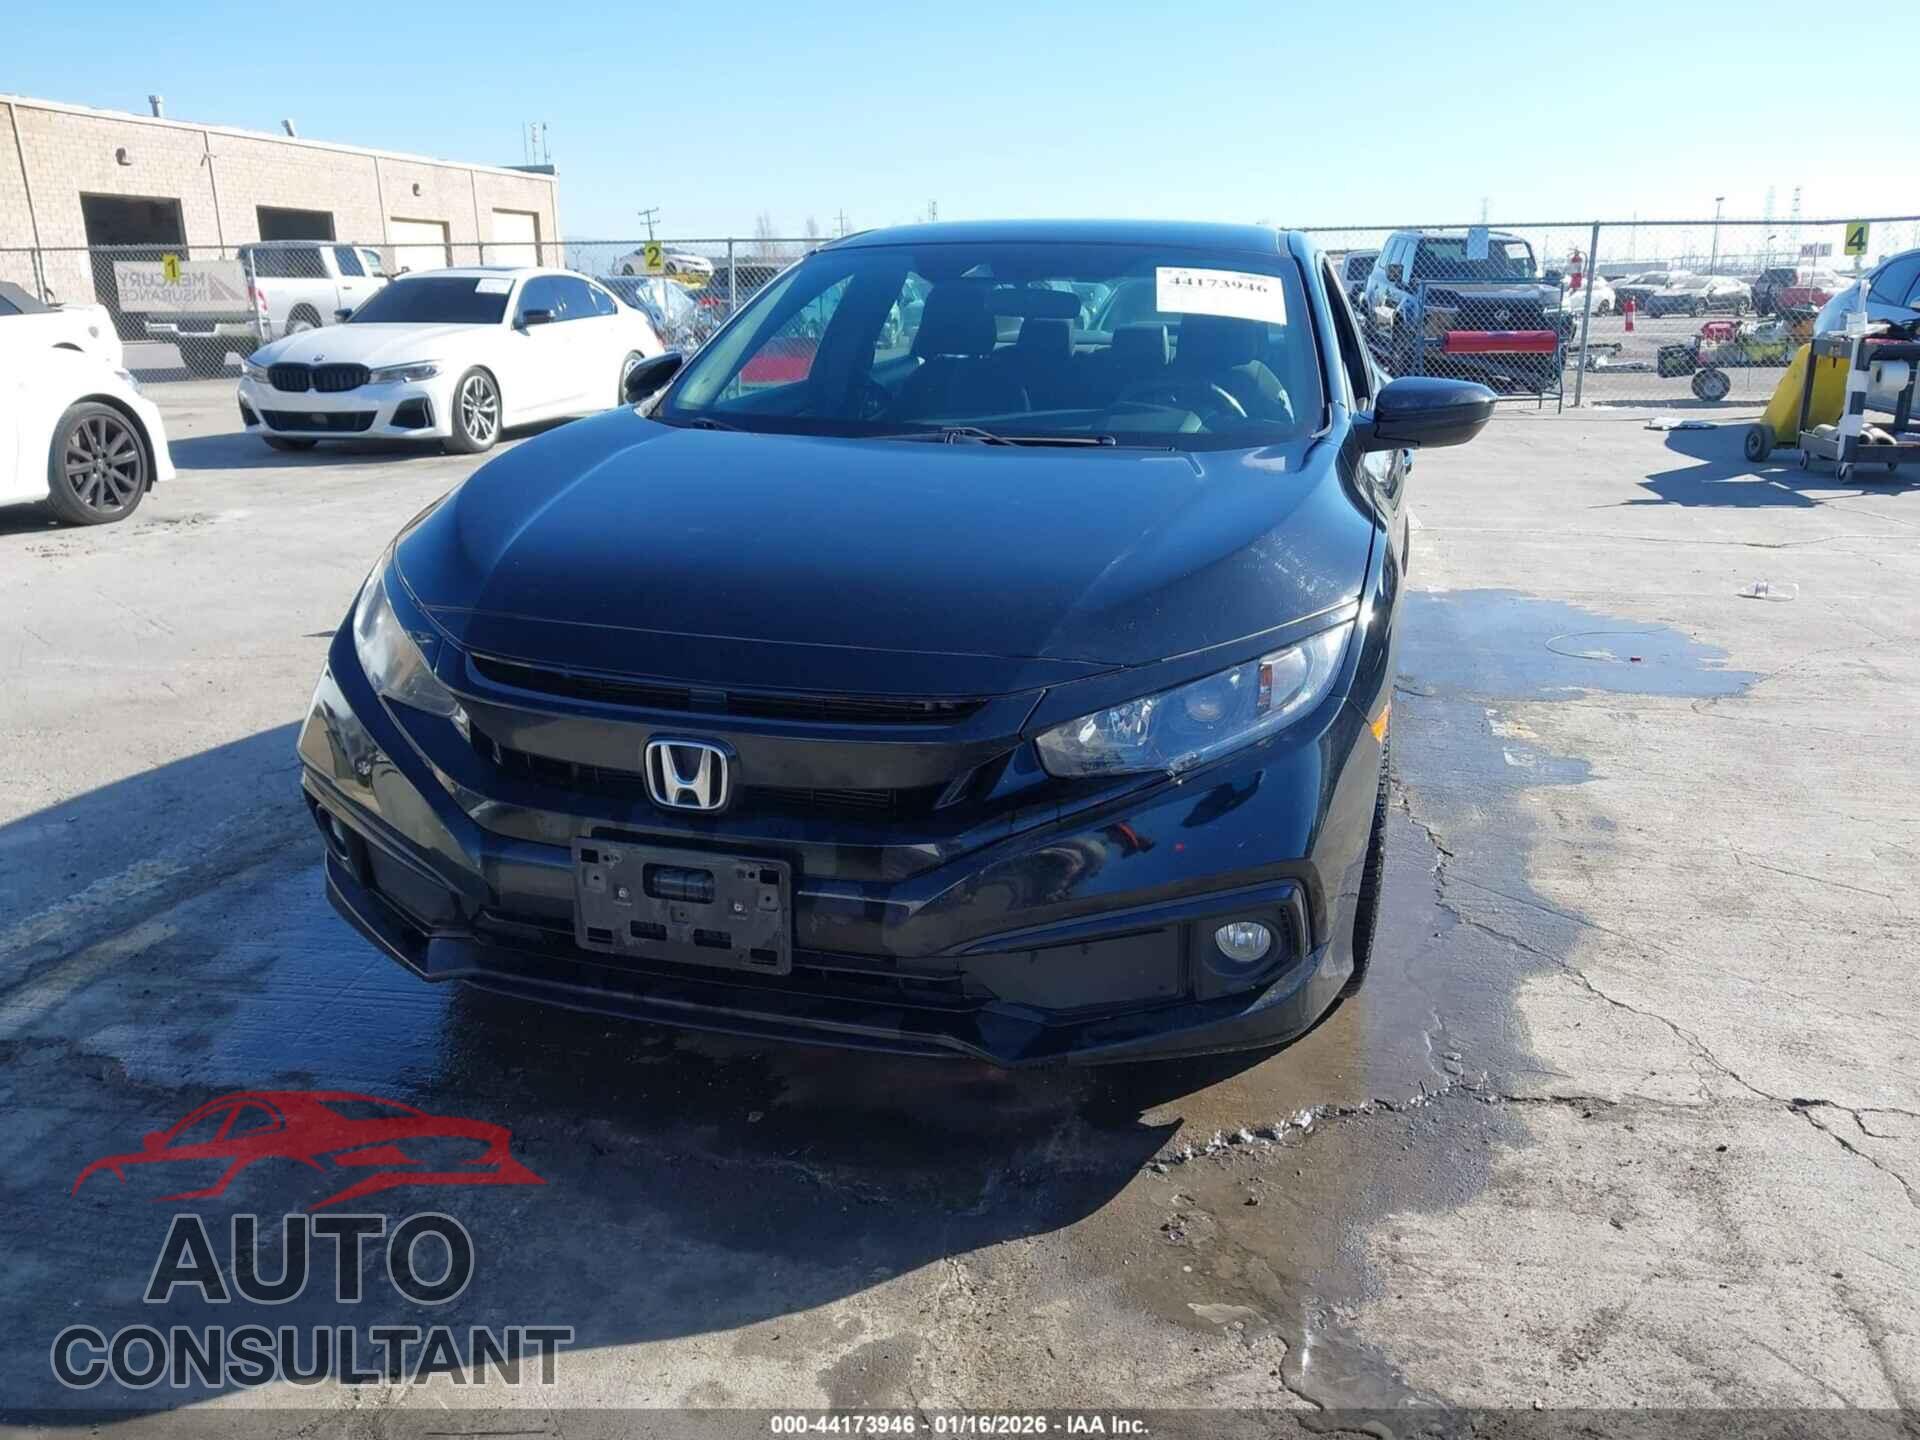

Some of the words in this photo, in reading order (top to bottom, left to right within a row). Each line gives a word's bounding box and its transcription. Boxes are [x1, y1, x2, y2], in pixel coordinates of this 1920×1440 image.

[1847, 227, 1866, 251] 4
[648, 246, 661, 267] 2
[167, 258, 177, 278] 1
